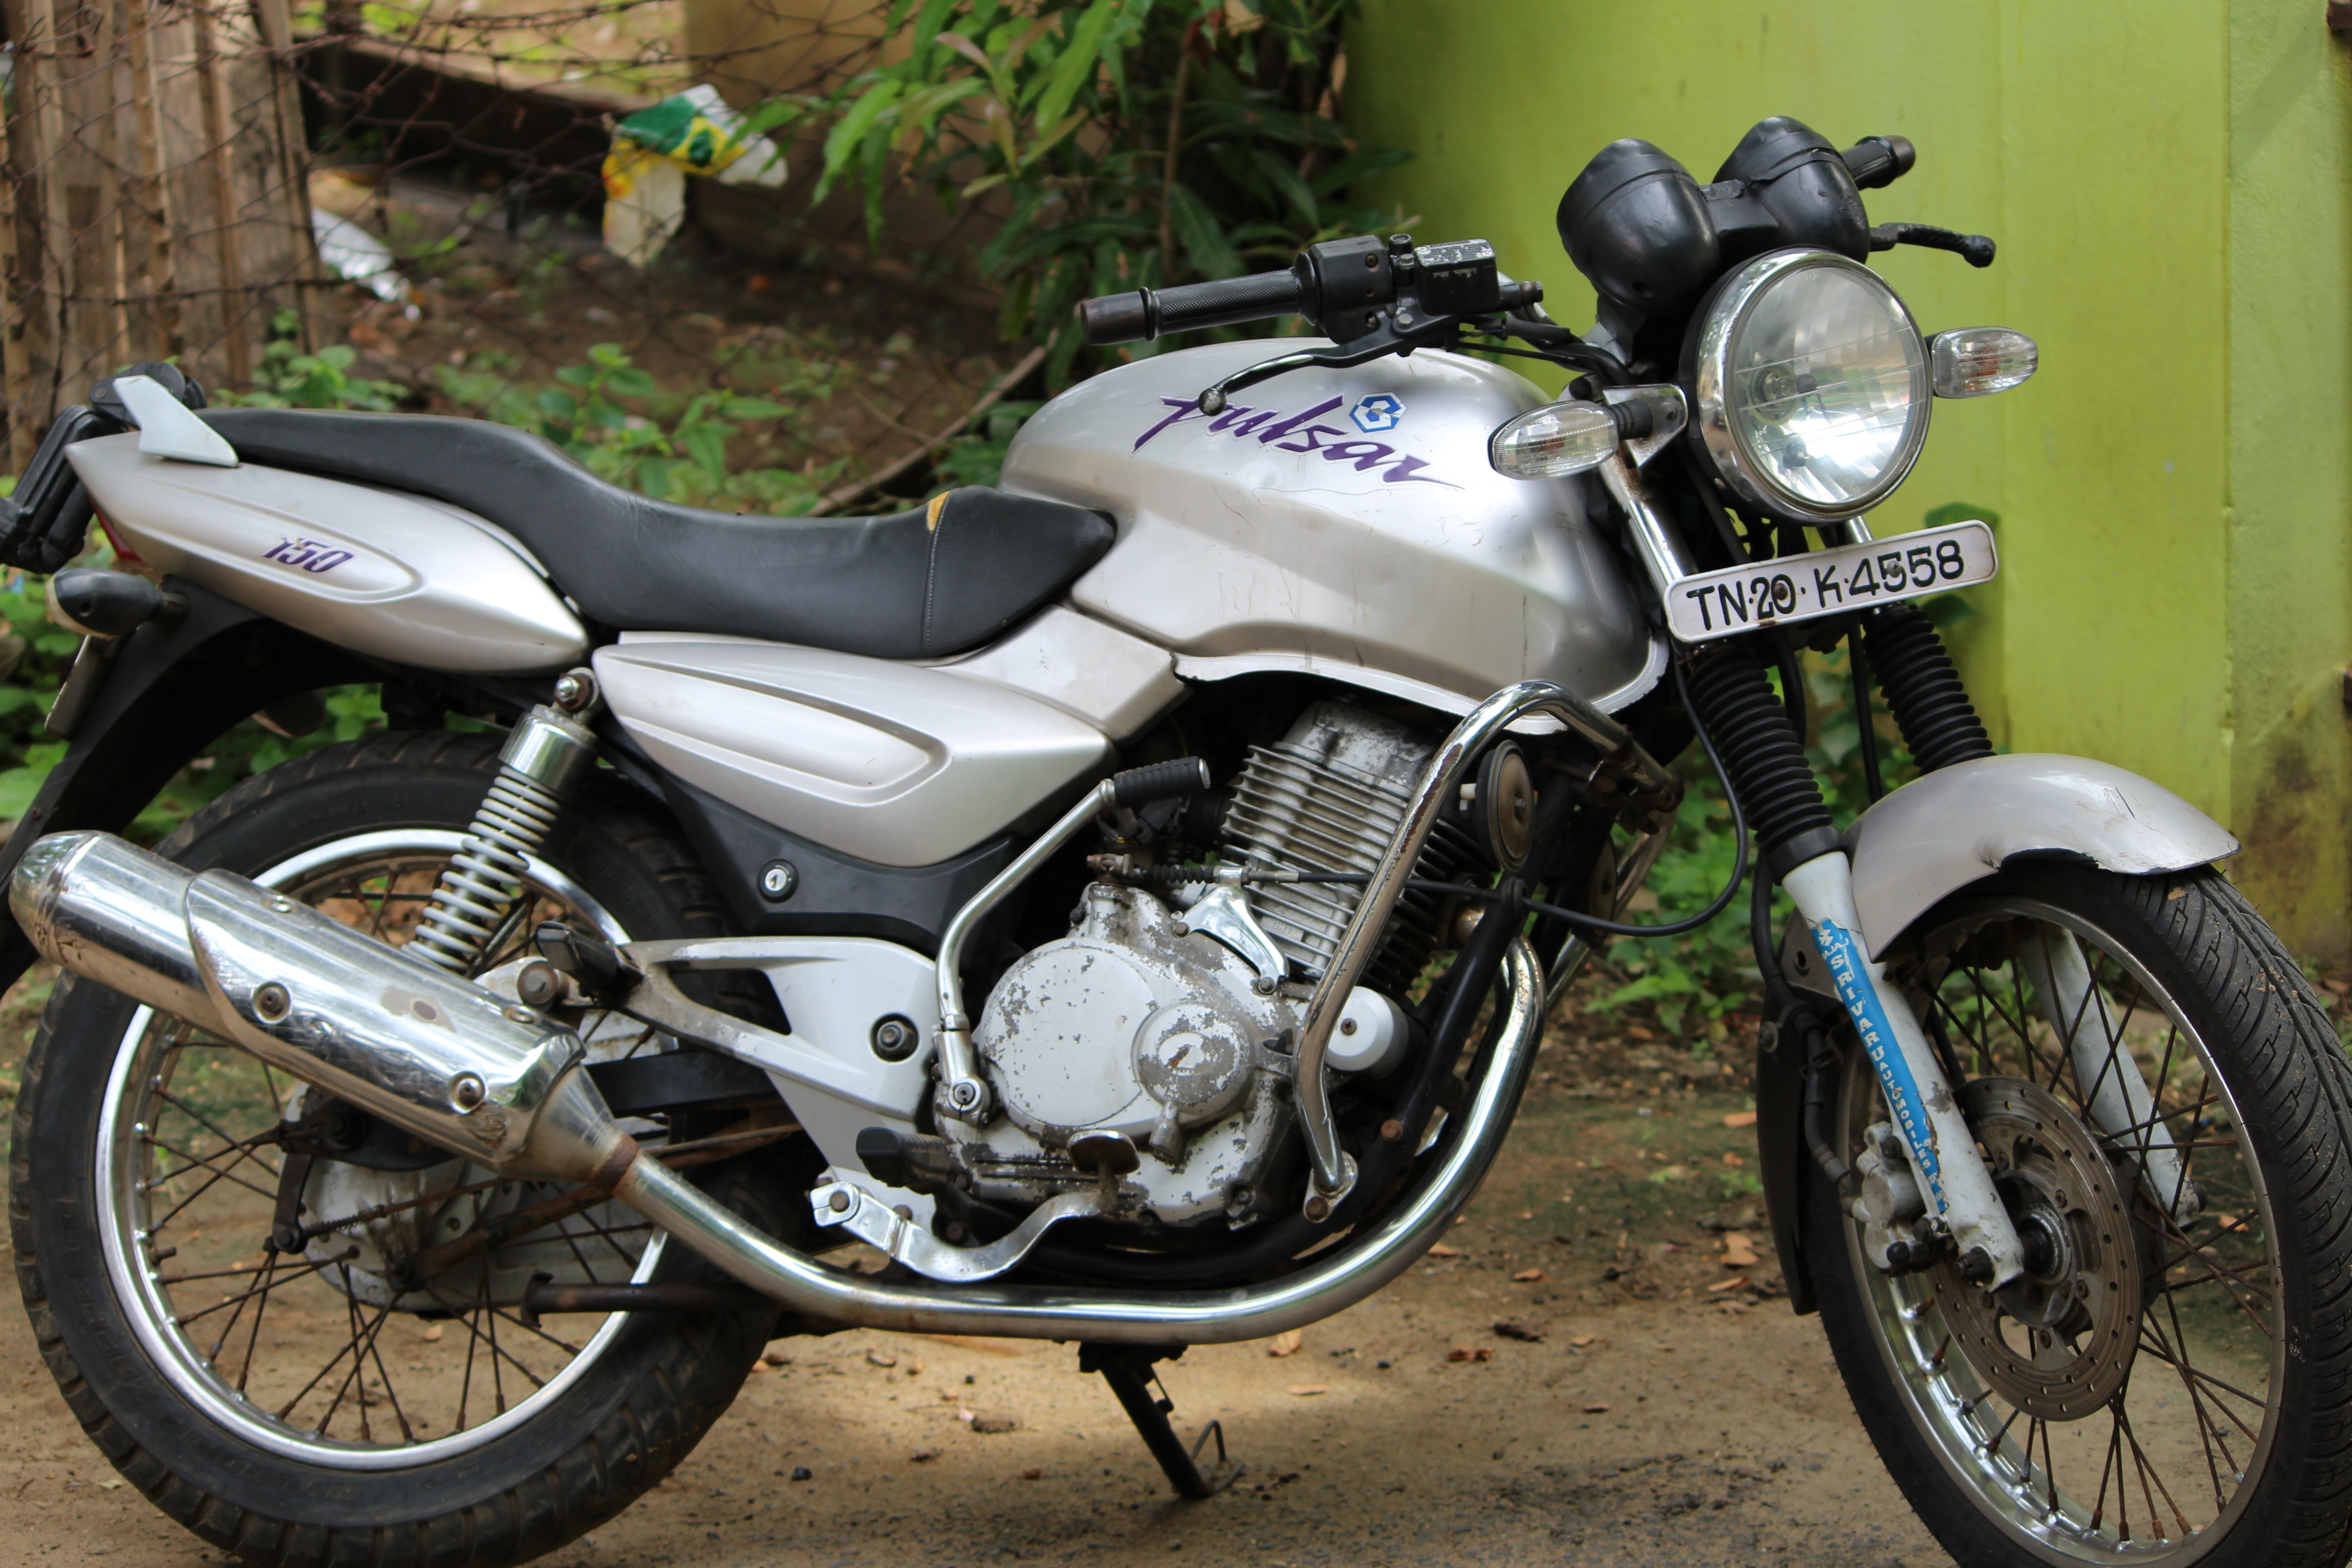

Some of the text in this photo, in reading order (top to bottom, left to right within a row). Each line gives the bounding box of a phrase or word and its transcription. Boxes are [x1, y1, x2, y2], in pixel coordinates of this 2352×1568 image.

[261, 534, 355, 573] 150
[1831, 954, 1885, 1061] SRIVARU
[1880, 1062, 1931, 1169] AUTOMOBILES
